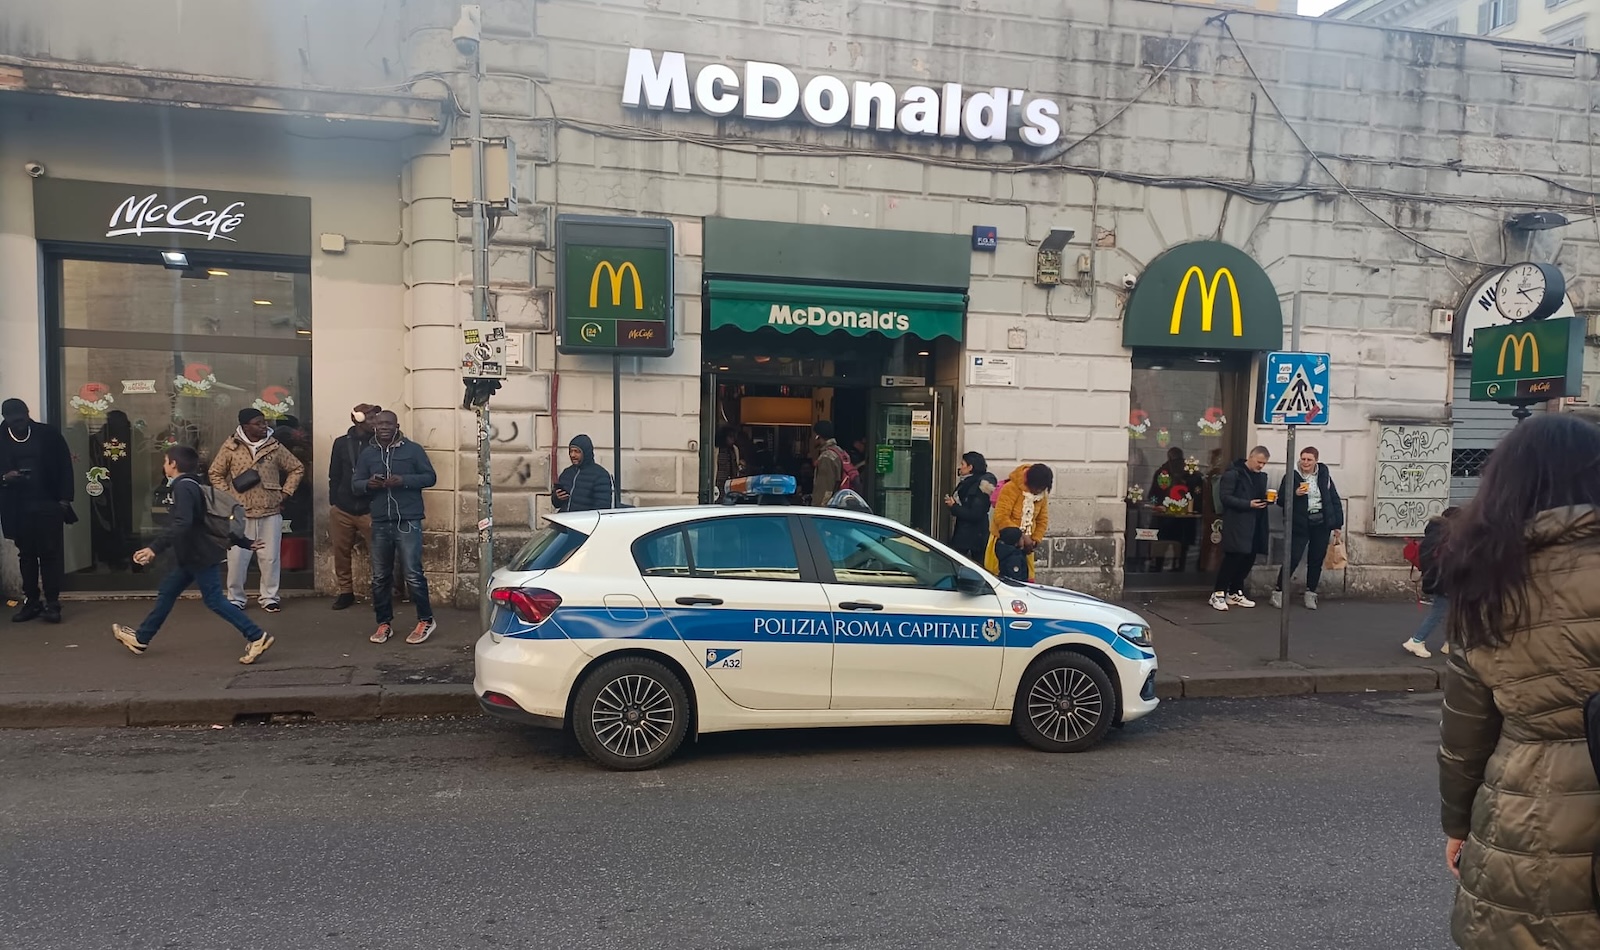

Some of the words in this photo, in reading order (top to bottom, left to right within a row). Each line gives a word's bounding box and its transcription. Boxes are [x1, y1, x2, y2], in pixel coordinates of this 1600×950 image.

[621, 47, 1062, 147] McDonald's
[106, 193, 246, 242] McCafé
[1522, 266, 1533, 277] 12
[1501, 288, 1508, 297] 9
[768, 304, 910, 331] McDonald's
[1516, 308, 1522, 317] 6
[753, 618, 829, 636] POLIZIA
[834, 620, 893, 637] ROMA
[898, 621, 980, 639] CAPITALE
[722, 659, 740, 668] A32
